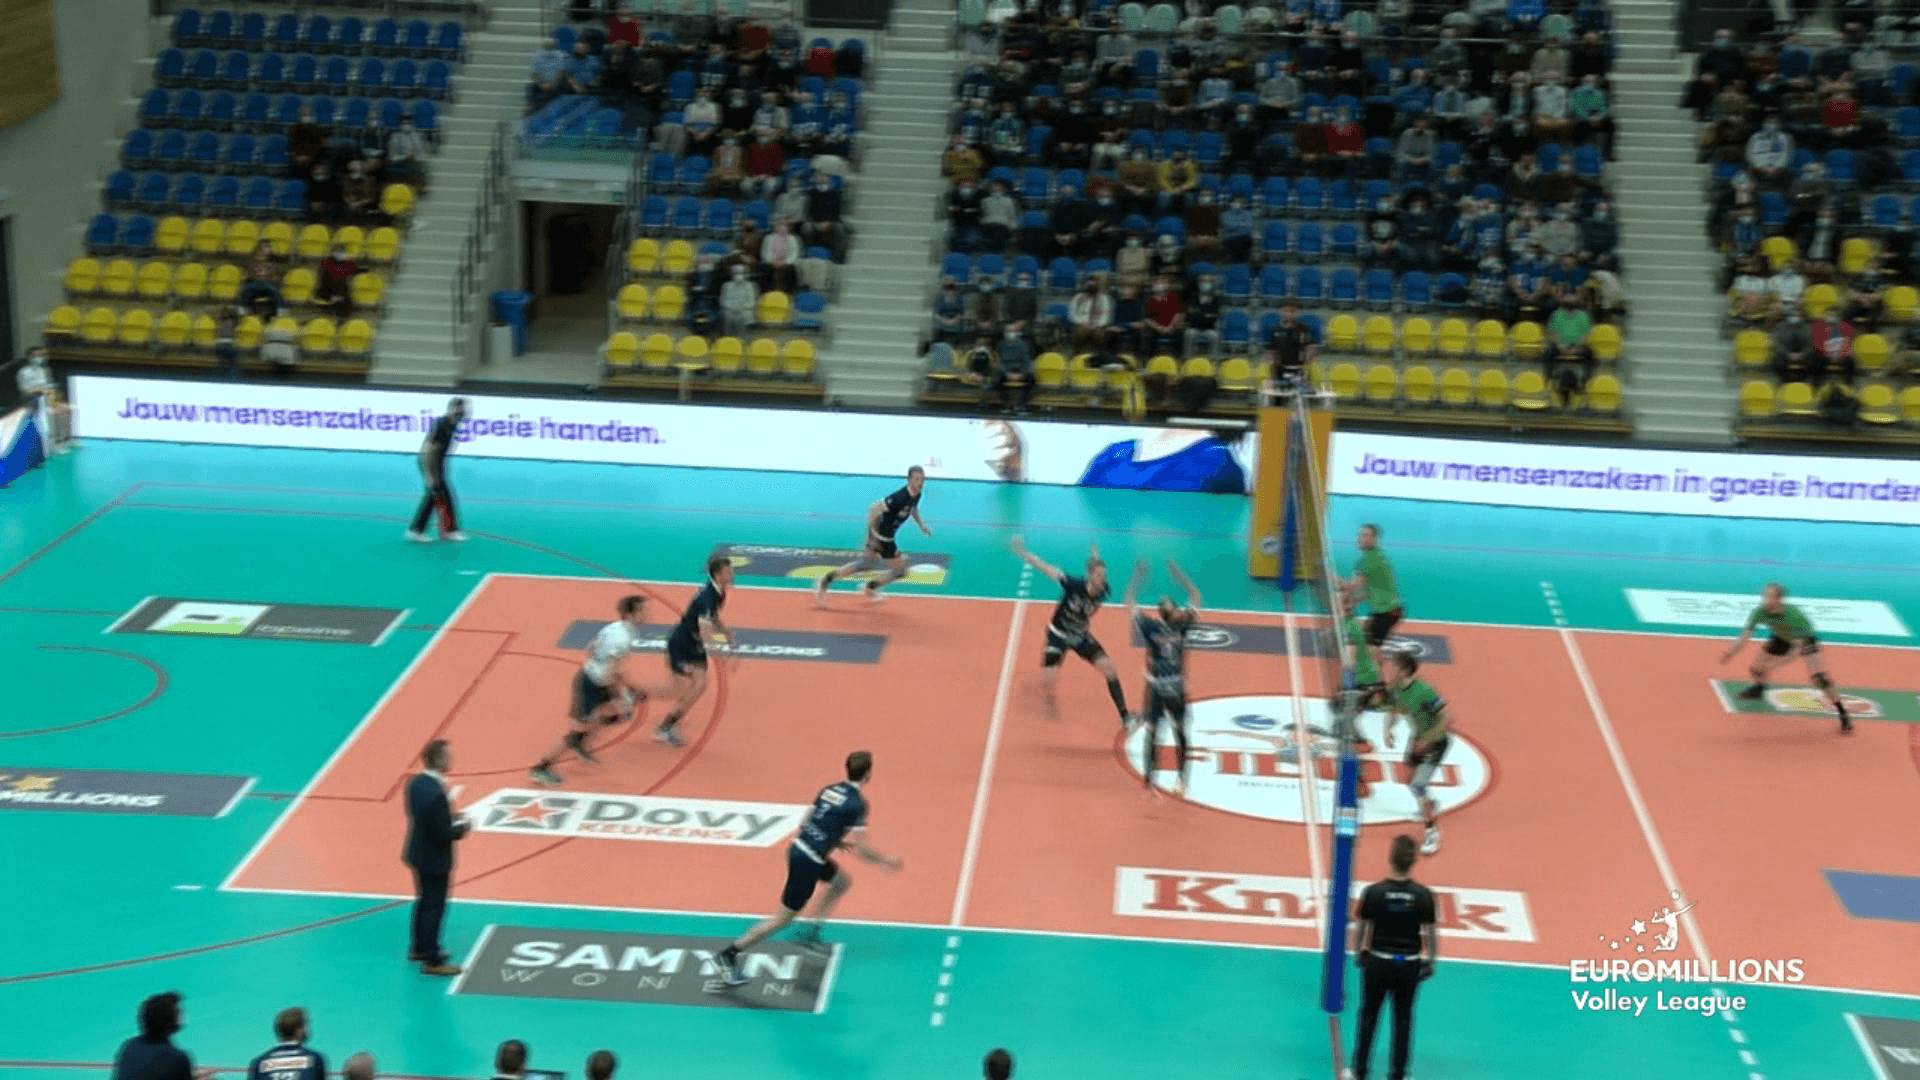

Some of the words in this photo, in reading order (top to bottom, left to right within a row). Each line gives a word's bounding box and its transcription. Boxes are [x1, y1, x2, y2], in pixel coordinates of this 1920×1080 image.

[117, 397, 199, 422] Jouw
[204, 404, 418, 432] mensenzaken
[539, 416, 666, 445] handen.
[1354, 453, 1440, 479] Jouw
[1443, 461, 1672, 493] mensenzaken
[1673, 468, 1708, 493] in
[1708, 472, 1802, 502] goeie
[577, 821, 740, 840] KEUKENS
[583, 800, 790, 840] Dovy
[1142, 873, 1512, 933] Knk
